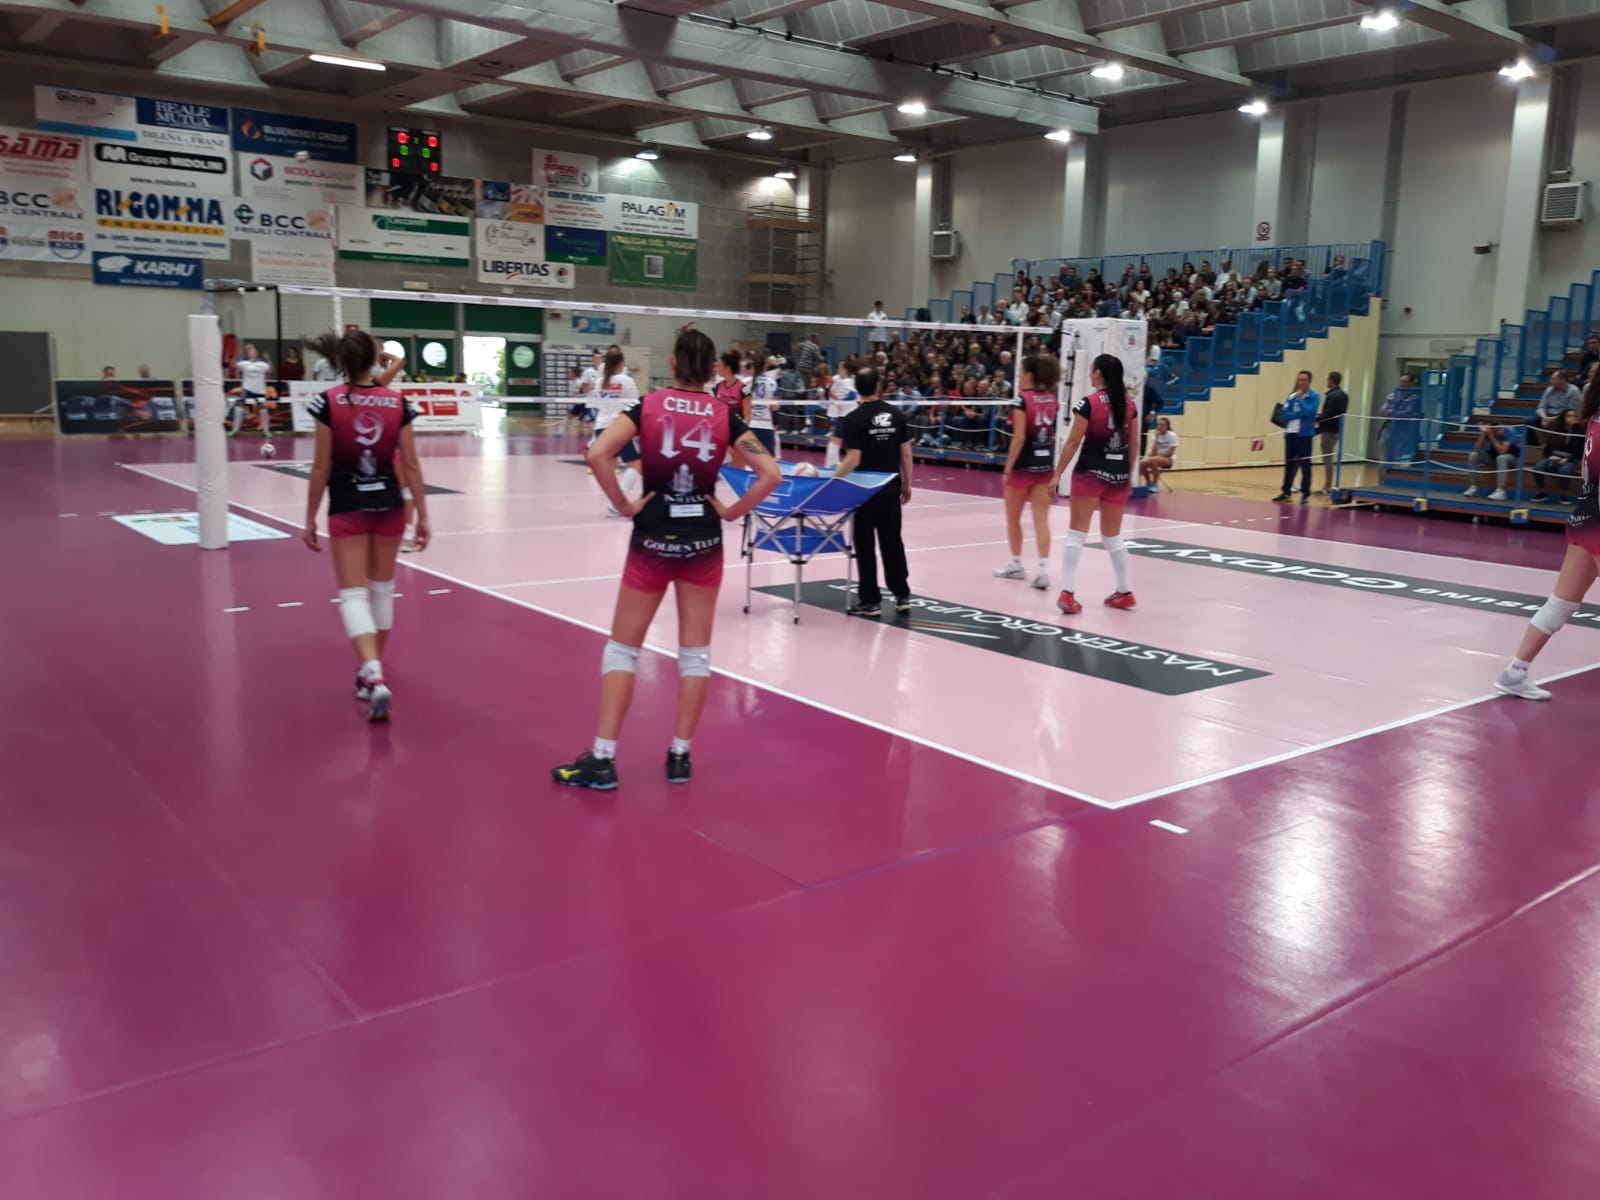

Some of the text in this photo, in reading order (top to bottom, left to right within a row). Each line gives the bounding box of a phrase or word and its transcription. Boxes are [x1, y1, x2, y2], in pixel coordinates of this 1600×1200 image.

[155, 101, 211, 117] REALE
[11, 207, 84, 220] CENTRALE
[260, 213, 305, 229] BCC
[274, 228, 332, 240] CENTRALE
[134, 260, 194, 276] KARHU
[482, 260, 549, 276] LIBERTAS
[663, 397, 715, 416] CELLA
[354, 410, 384, 446] 9
[657, 414, 718, 462] 14
[1148, 549, 1409, 590] Galaxy
[1061, 632, 1244, 677] MASTER
